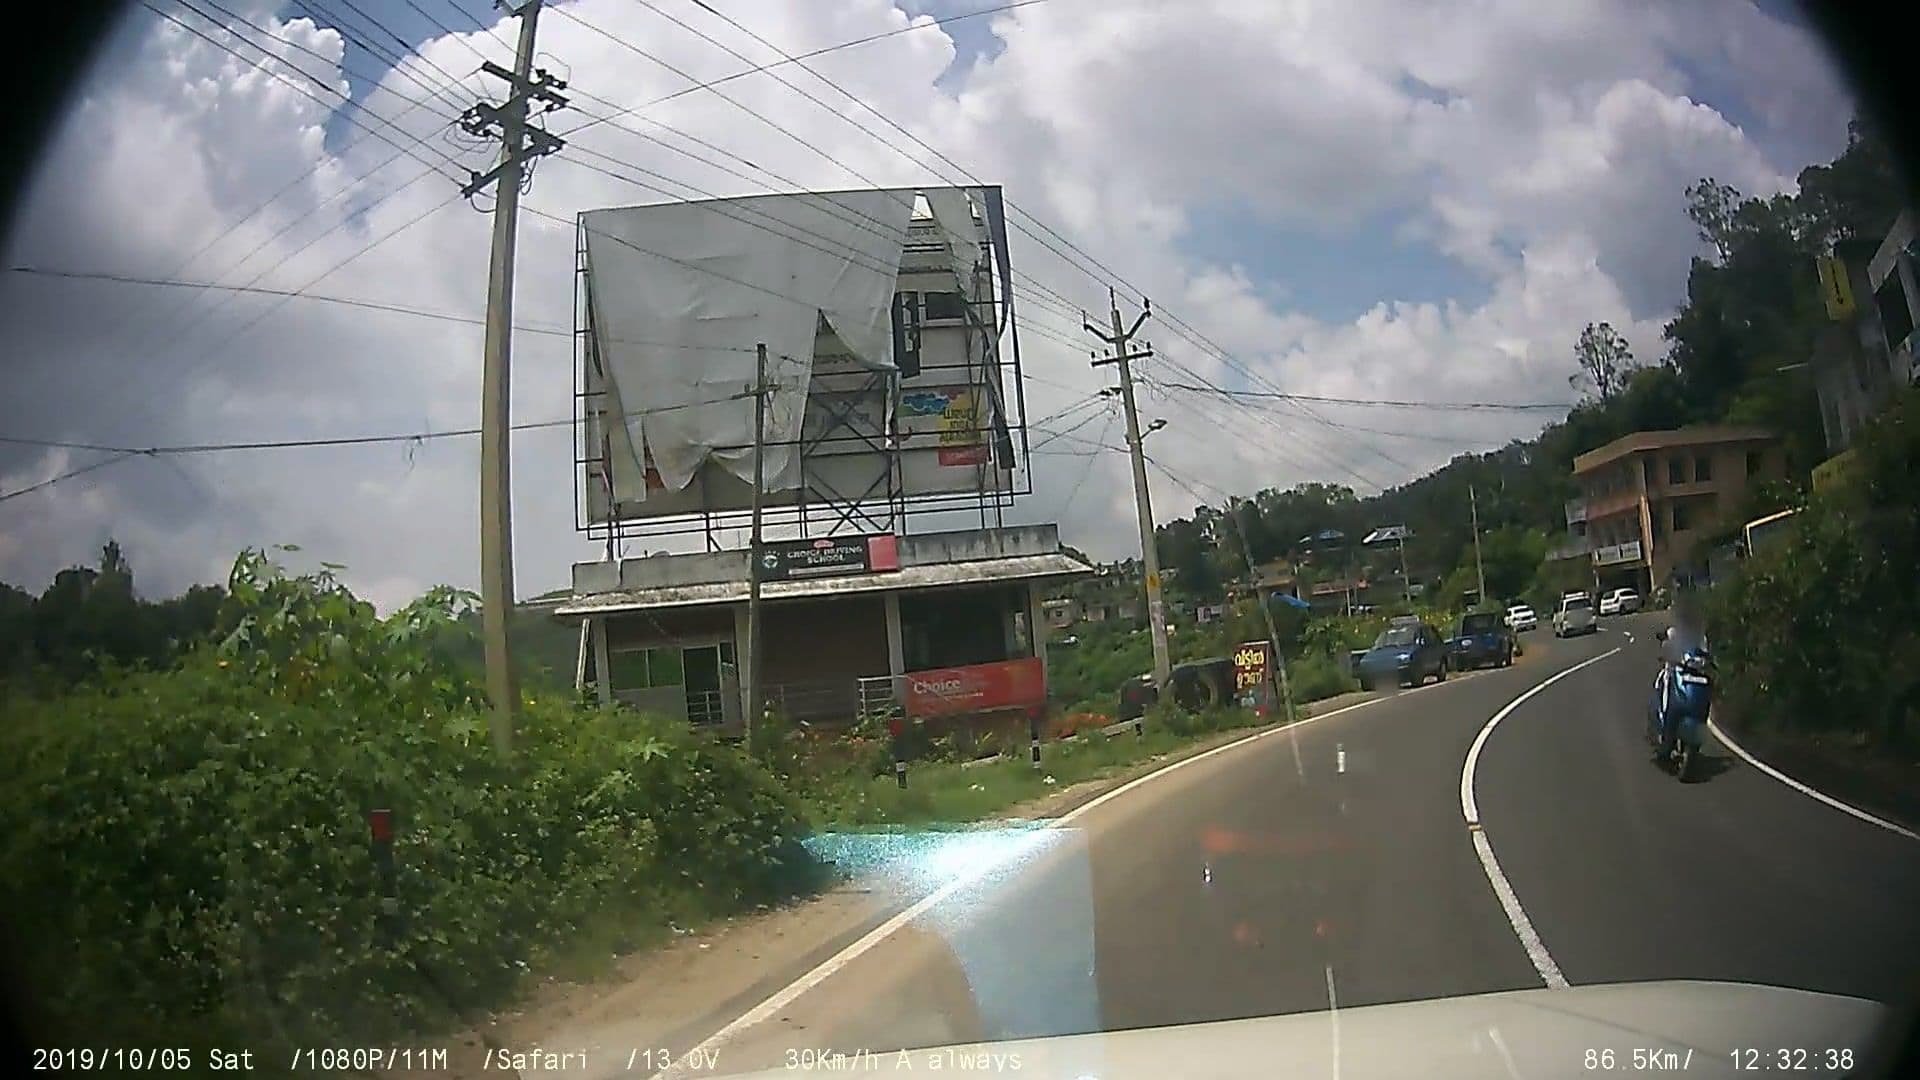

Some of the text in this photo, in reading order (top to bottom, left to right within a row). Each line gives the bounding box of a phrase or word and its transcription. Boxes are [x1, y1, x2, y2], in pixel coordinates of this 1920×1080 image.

[787, 545, 863, 559] CHOICE DRIVING
[807, 554, 845, 564] SCHOOL
[913, 678, 961, 695] Choice
